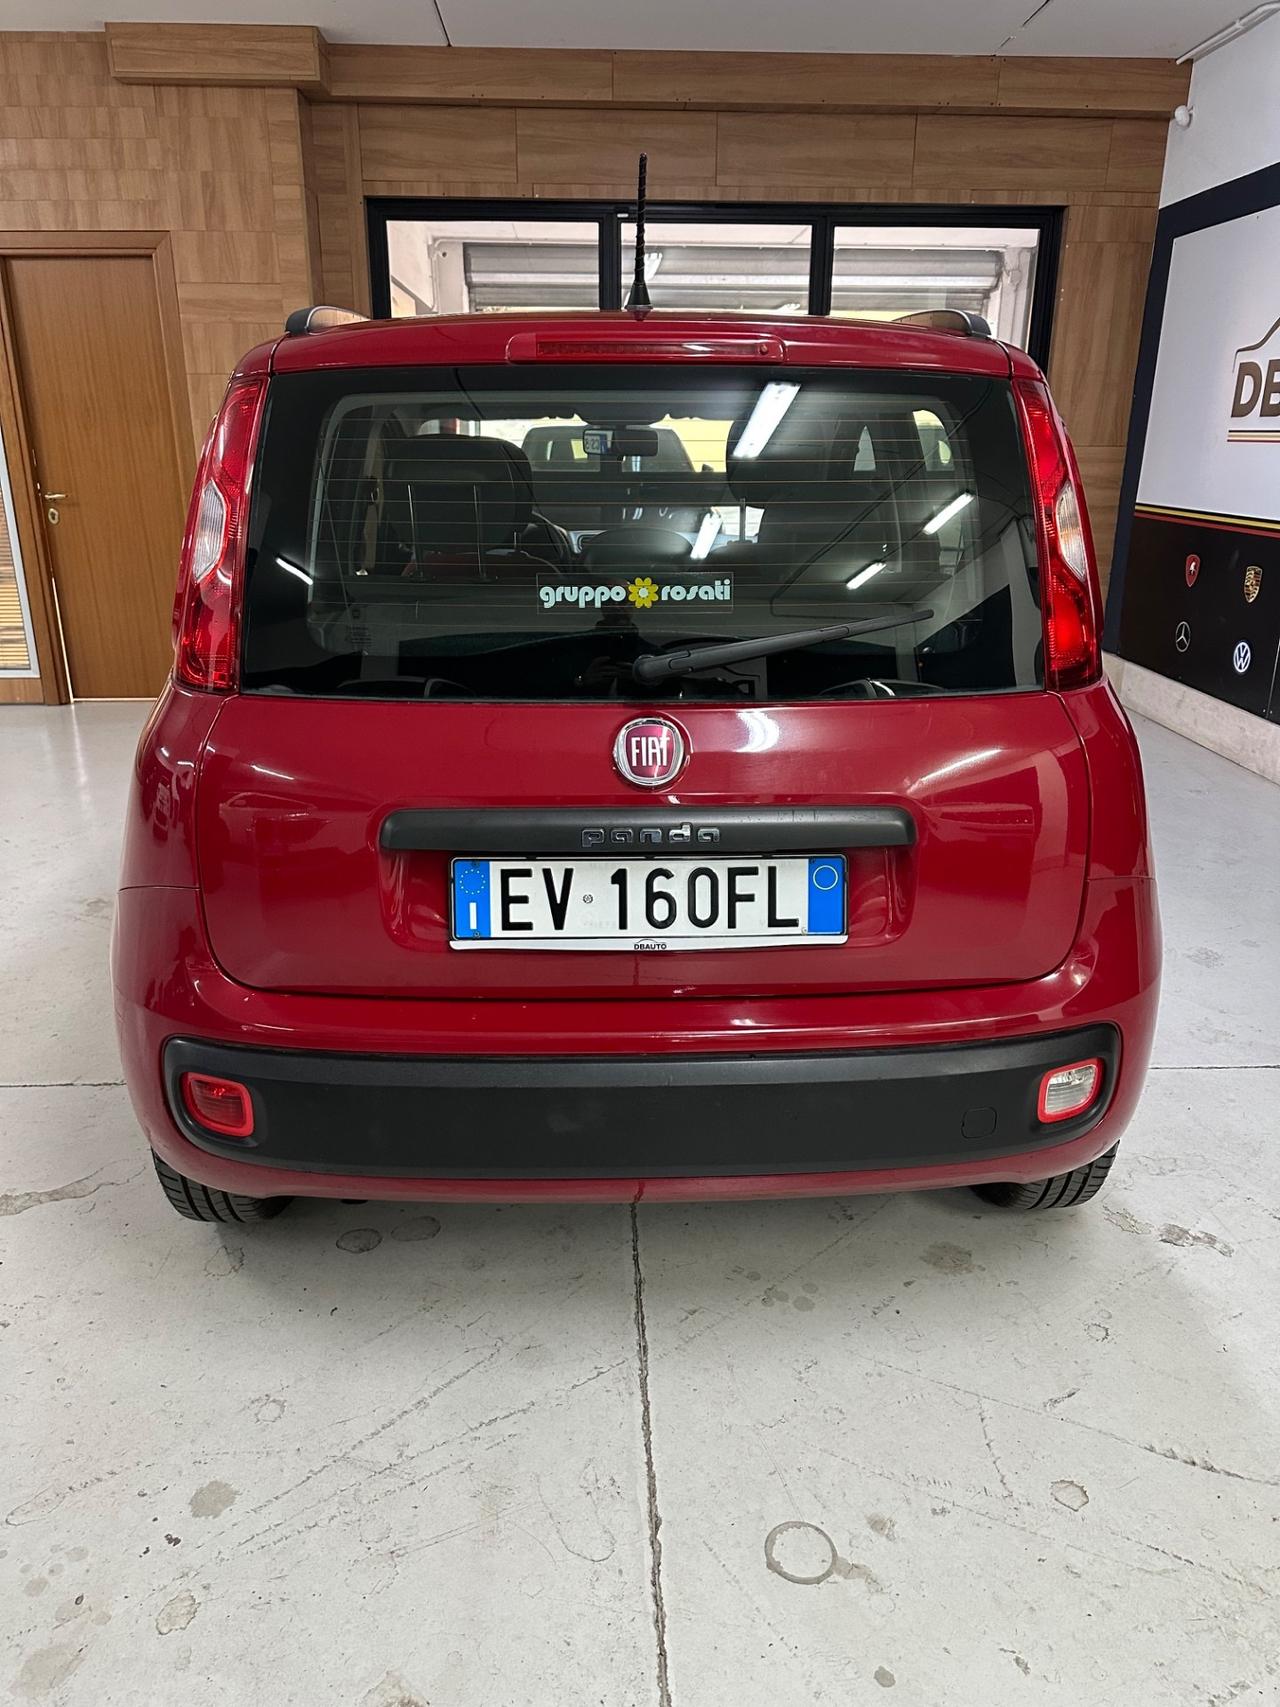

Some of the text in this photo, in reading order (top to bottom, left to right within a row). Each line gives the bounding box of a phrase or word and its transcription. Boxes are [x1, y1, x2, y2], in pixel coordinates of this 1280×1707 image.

[539, 578, 731, 608] gruppo rosati
[631, 736, 671, 767] FIAT
[581, 821, 720, 848] panda
[500, 866, 799, 931] EV 160FL
[633, 942, 667, 951] DBAUTO
